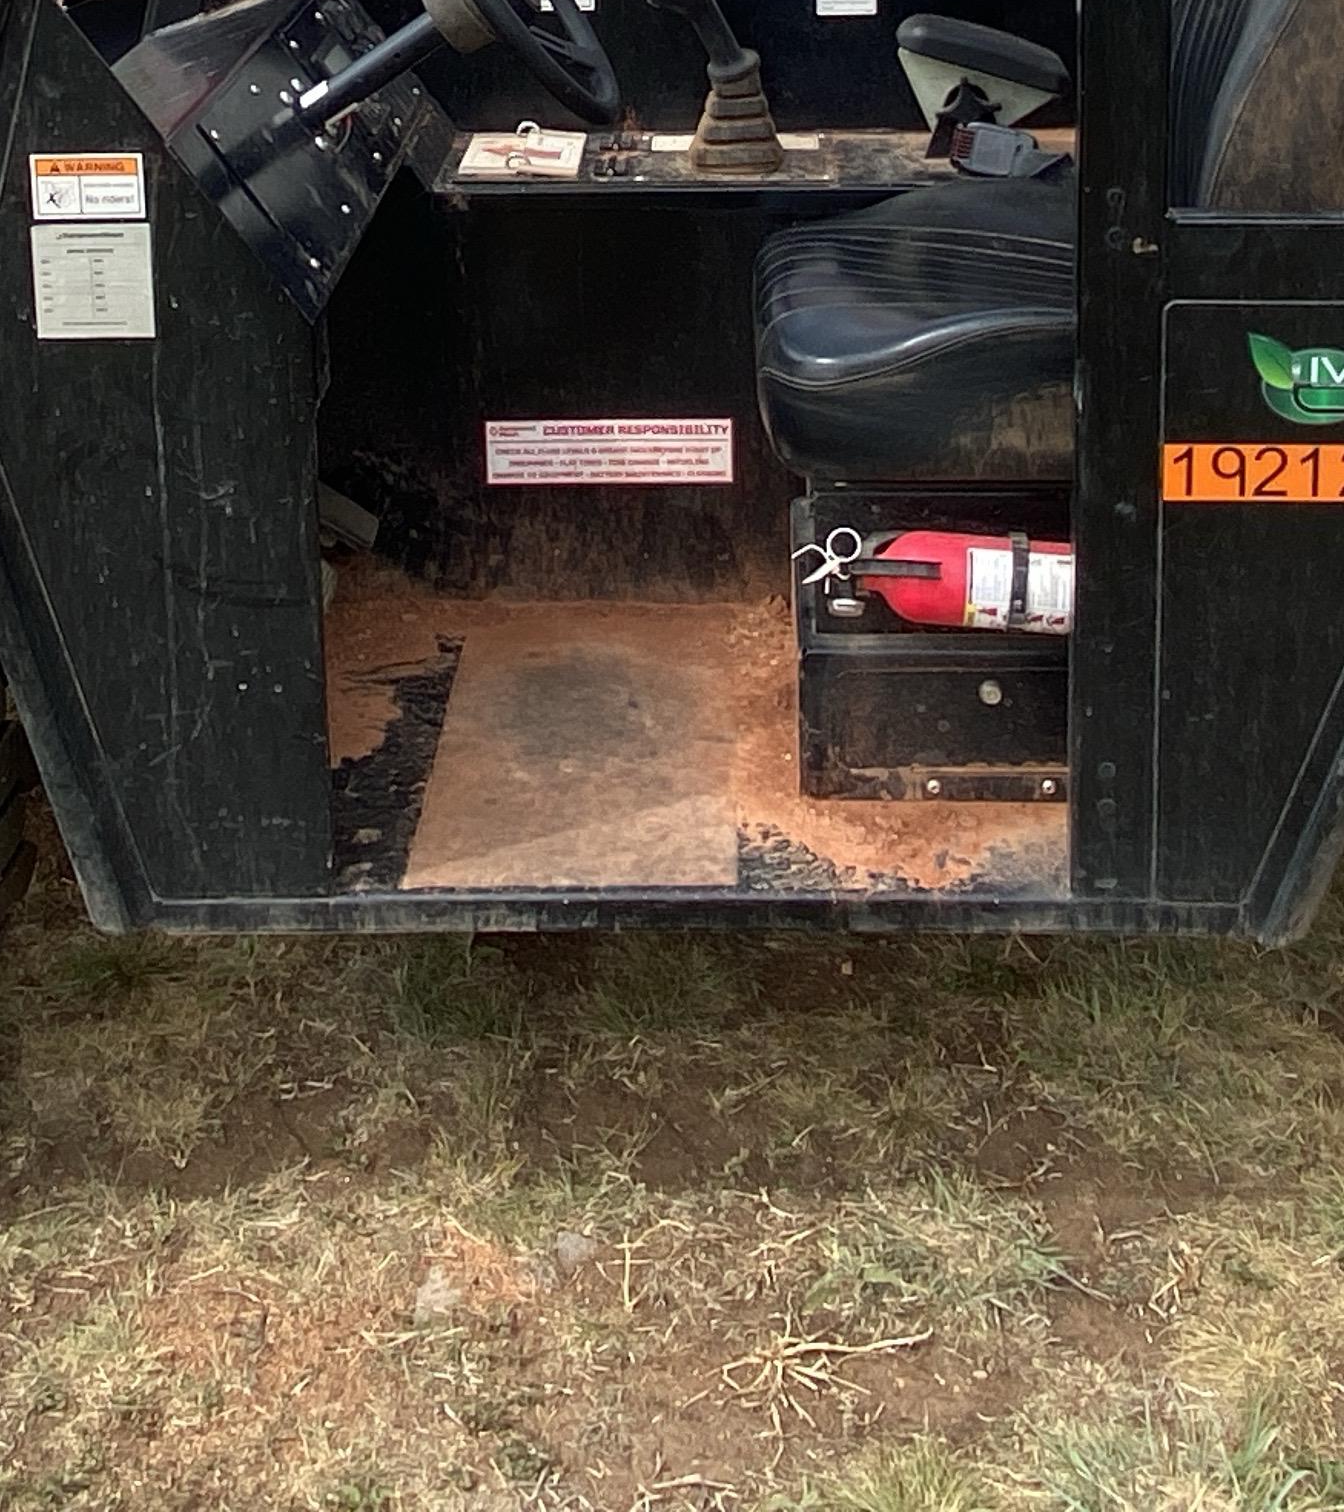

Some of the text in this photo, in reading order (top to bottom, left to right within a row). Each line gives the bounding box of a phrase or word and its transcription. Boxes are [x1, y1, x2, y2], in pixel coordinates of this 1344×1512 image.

[64, 162, 125, 173] WARNING
[542, 424, 615, 436] CUSTOMER
[617, 423, 729, 436] RESPONSIBILITY
